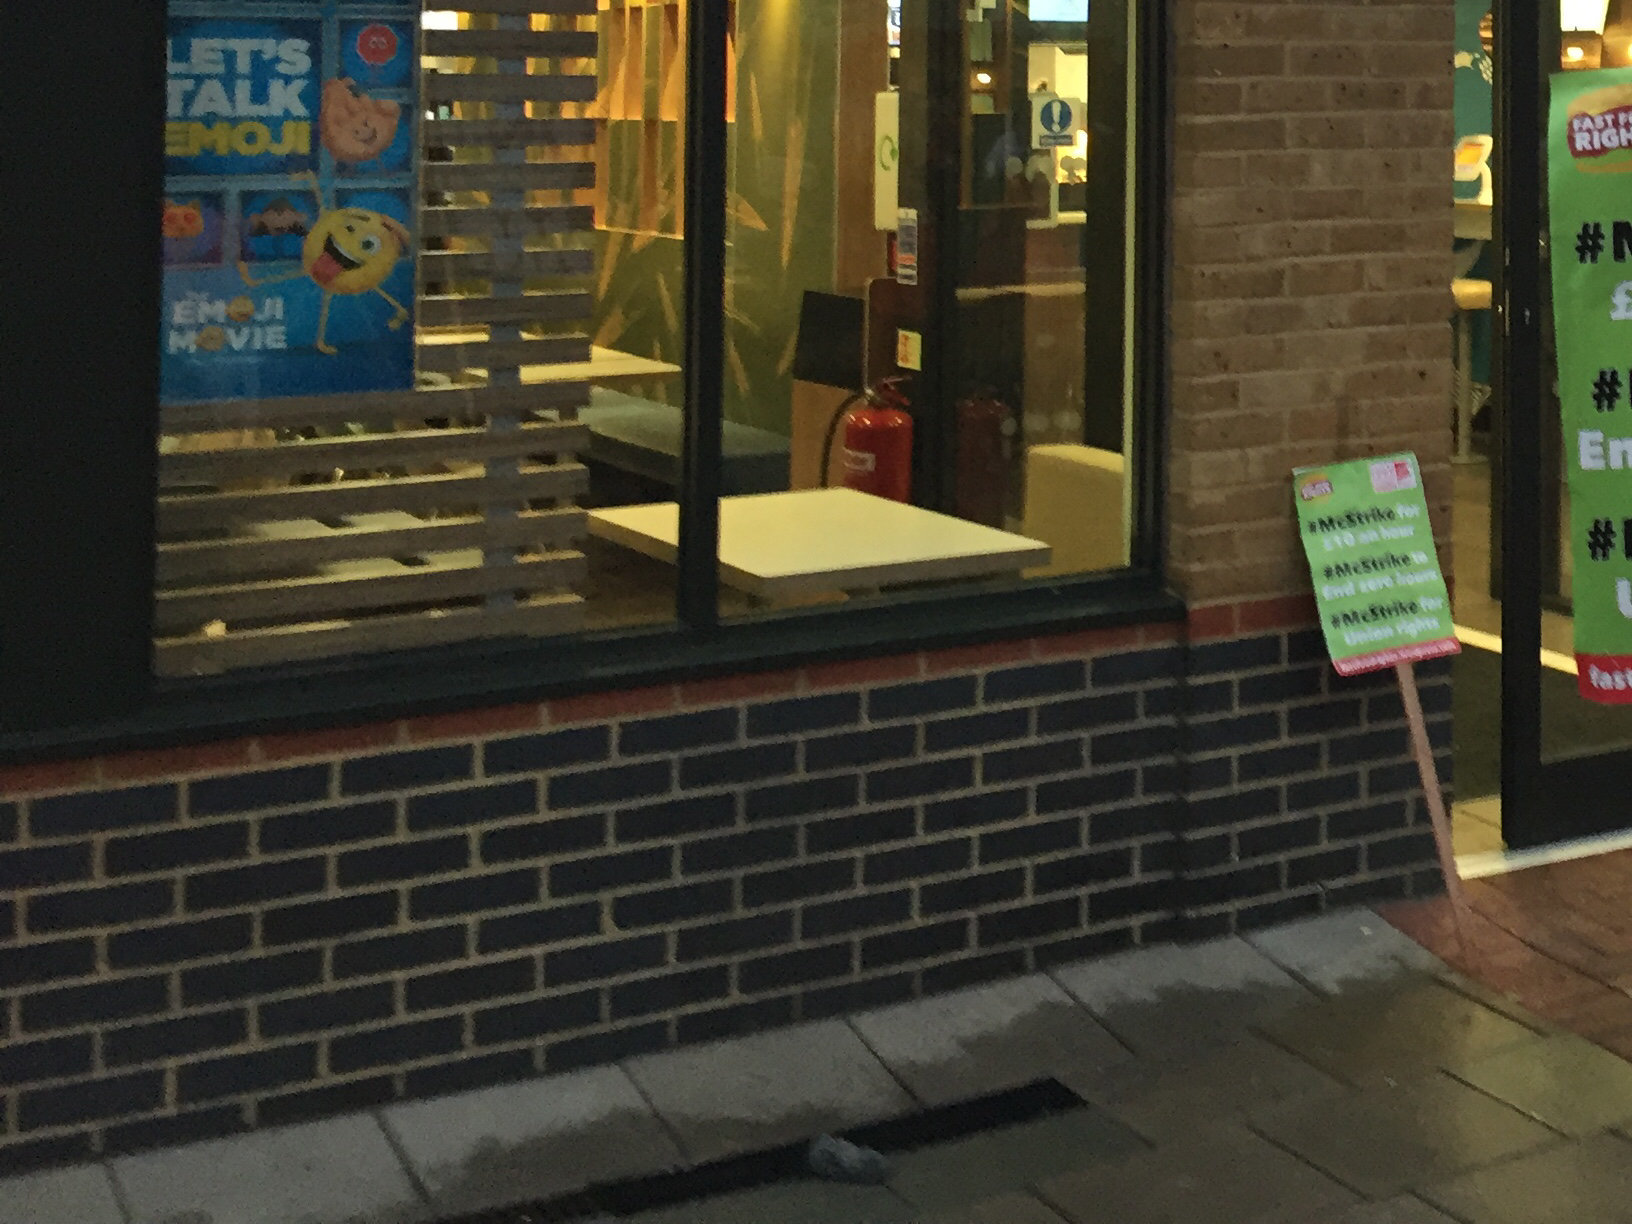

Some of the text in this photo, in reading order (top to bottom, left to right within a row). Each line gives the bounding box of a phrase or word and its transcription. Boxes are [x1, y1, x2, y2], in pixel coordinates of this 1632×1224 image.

[165, 37, 312, 76] LET'S
[165, 78, 311, 118] TALK
[164, 119, 312, 157] EMOJI
[1572, 113, 1615, 131] FAST
